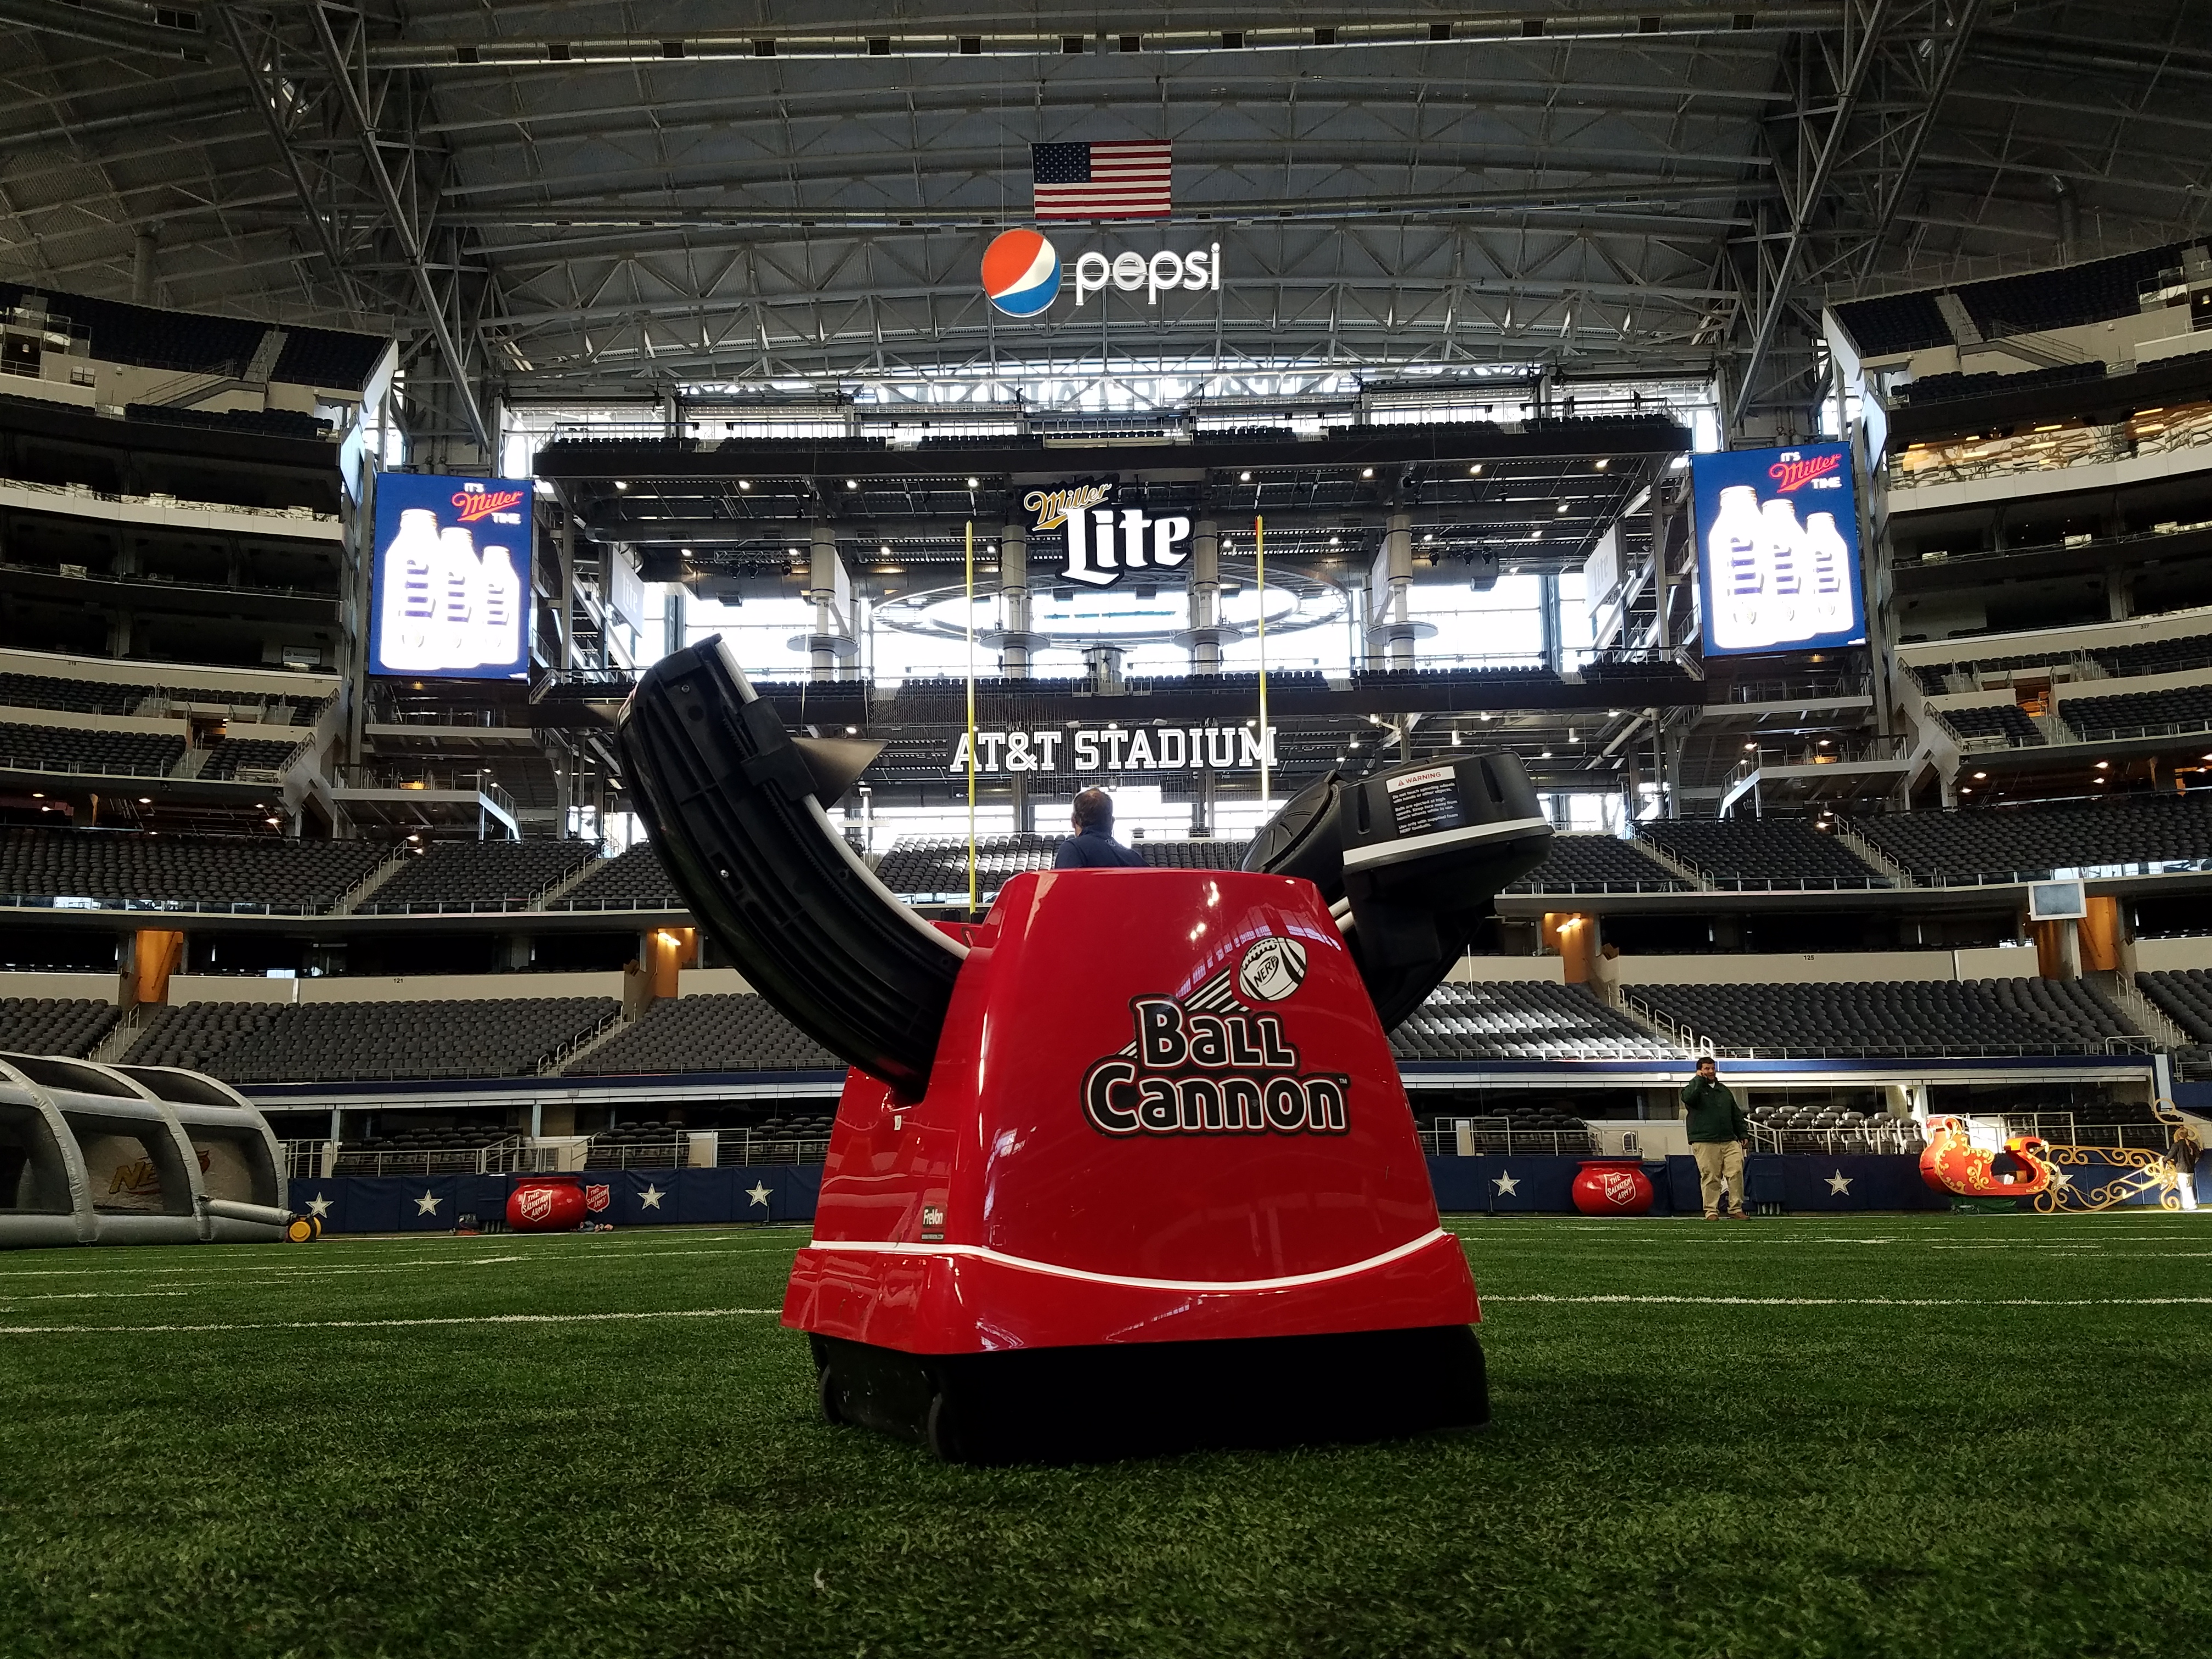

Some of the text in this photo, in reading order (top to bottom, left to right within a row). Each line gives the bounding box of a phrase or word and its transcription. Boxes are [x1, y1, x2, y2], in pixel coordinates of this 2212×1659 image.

[1075, 242, 1220, 306] pepsi
[1781, 452, 1801, 462] IT'S
[1769, 454, 1842, 488] Miller
[464, 482, 484, 493] IT'S
[452, 491, 524, 518] Miller
[1024, 483, 1112, 531] Miller
[1061, 509, 1190, 585] Lite
[950, 726, 1278, 772] AT&T STADIUM
[1406, 772, 1441, 783] WARNING
[1254, 955, 1277, 988] NERF
[1087, 1062, 1345, 1132] Cannon
[1607, 1177, 1632, 1197] SALVATION
[1609, 1175, 1621, 1185] THE
[527, 1191, 540, 1202] THE
[587, 1188, 608, 1205] SALVATION
[590, 1187, 600, 1195] THE
[1617, 1187, 1633, 1200] ARMY
[522, 1193, 550, 1214] SALVATION
[531, 1203, 548, 1218] ARMY
[593, 1196, 607, 1209] ARMY
